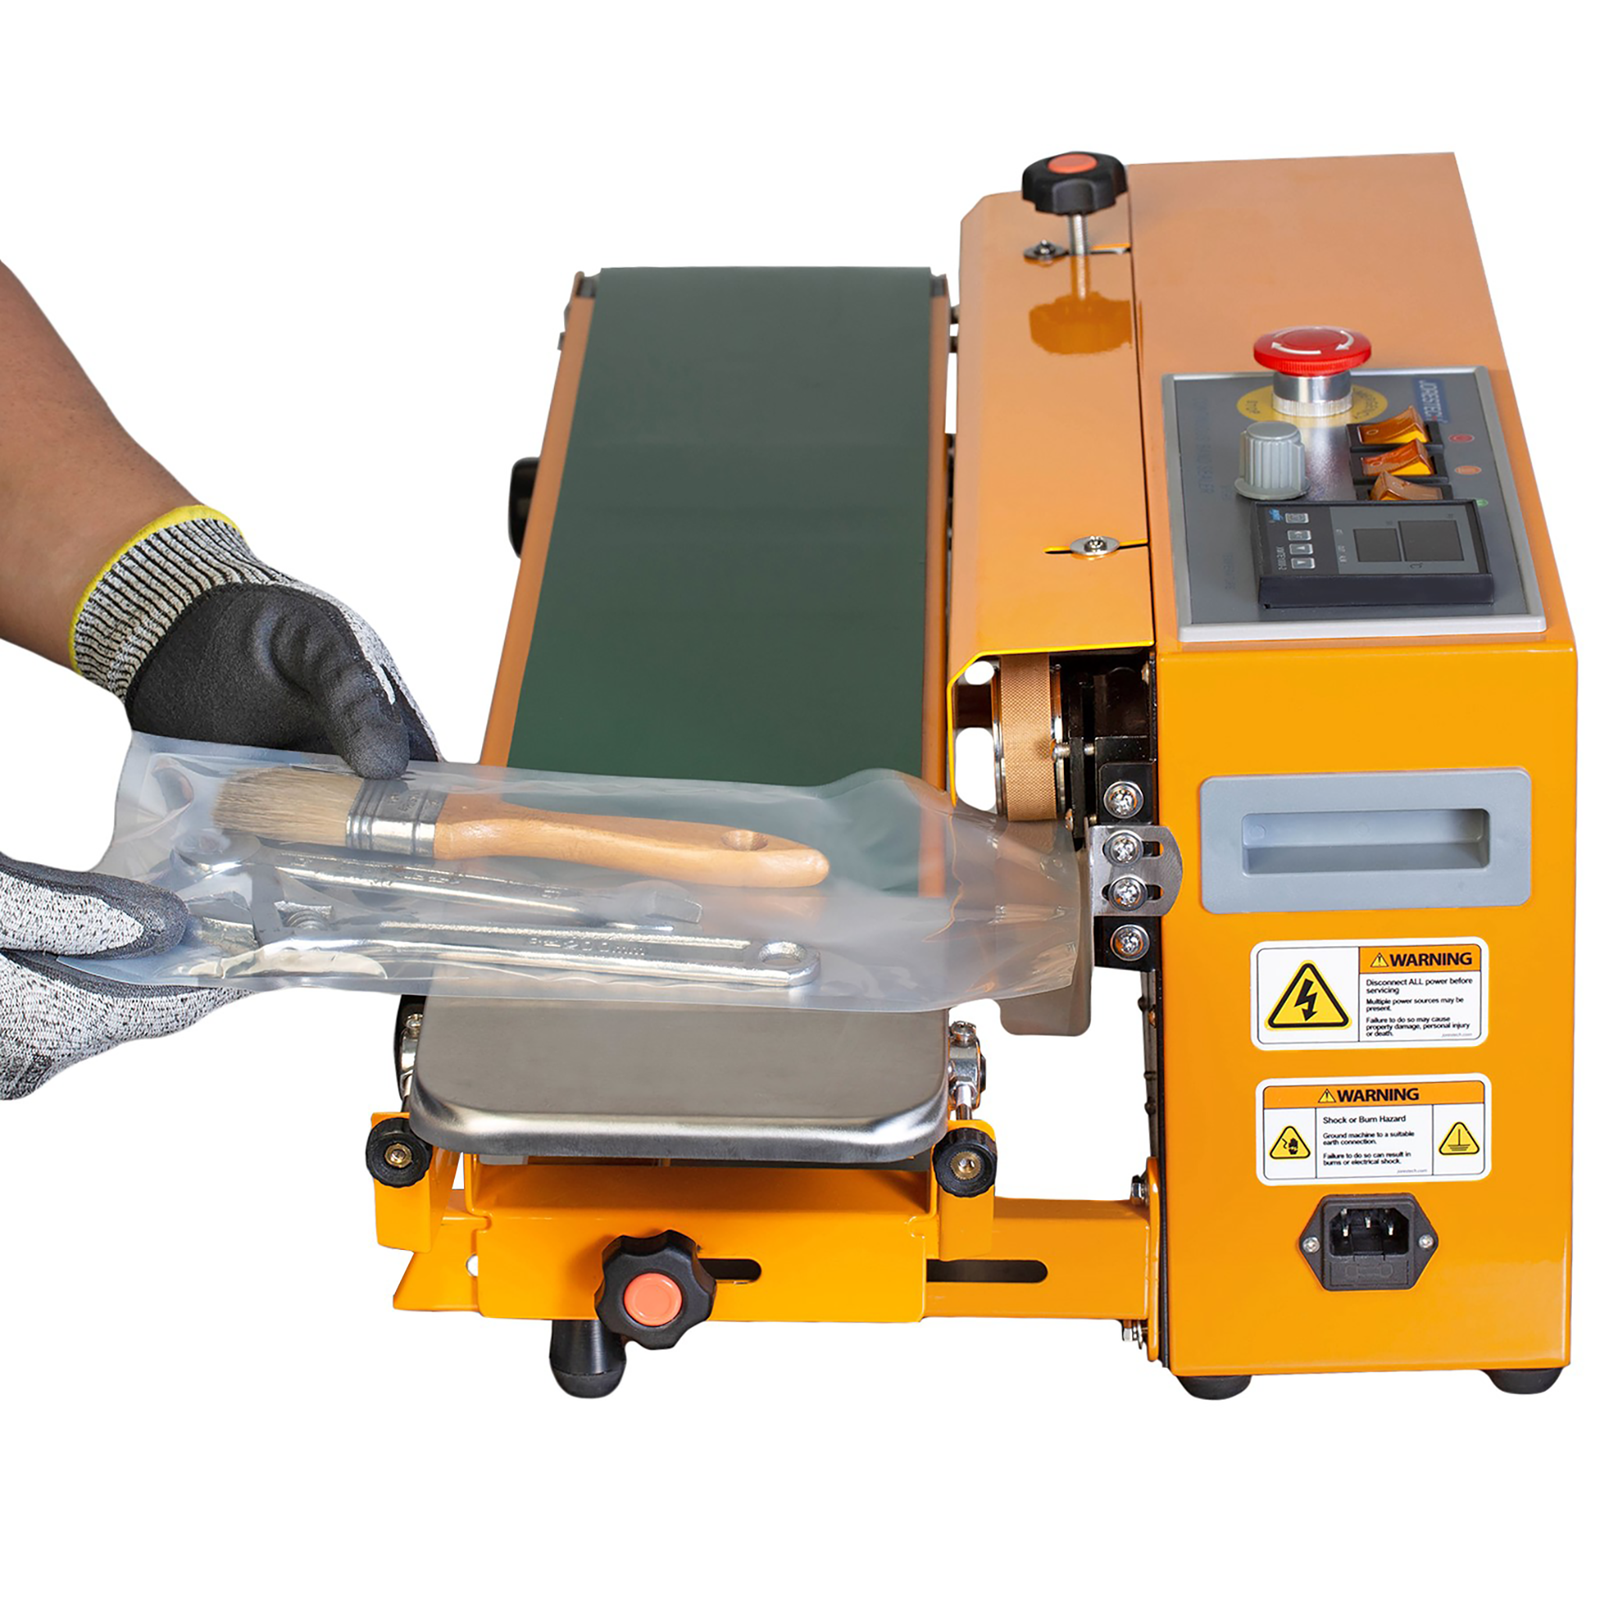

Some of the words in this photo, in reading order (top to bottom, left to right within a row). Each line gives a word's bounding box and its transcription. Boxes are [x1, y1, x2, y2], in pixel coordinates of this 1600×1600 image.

[1389, 952, 1473, 967] WARNING
[1366, 978, 1407, 986] Disconnect
[1425, 978, 1448, 986] power
[1366, 986, 1400, 995] servicing
[1337, 1088, 1420, 1103] WARNING
[1322, 1116, 1347, 1124] Shock
